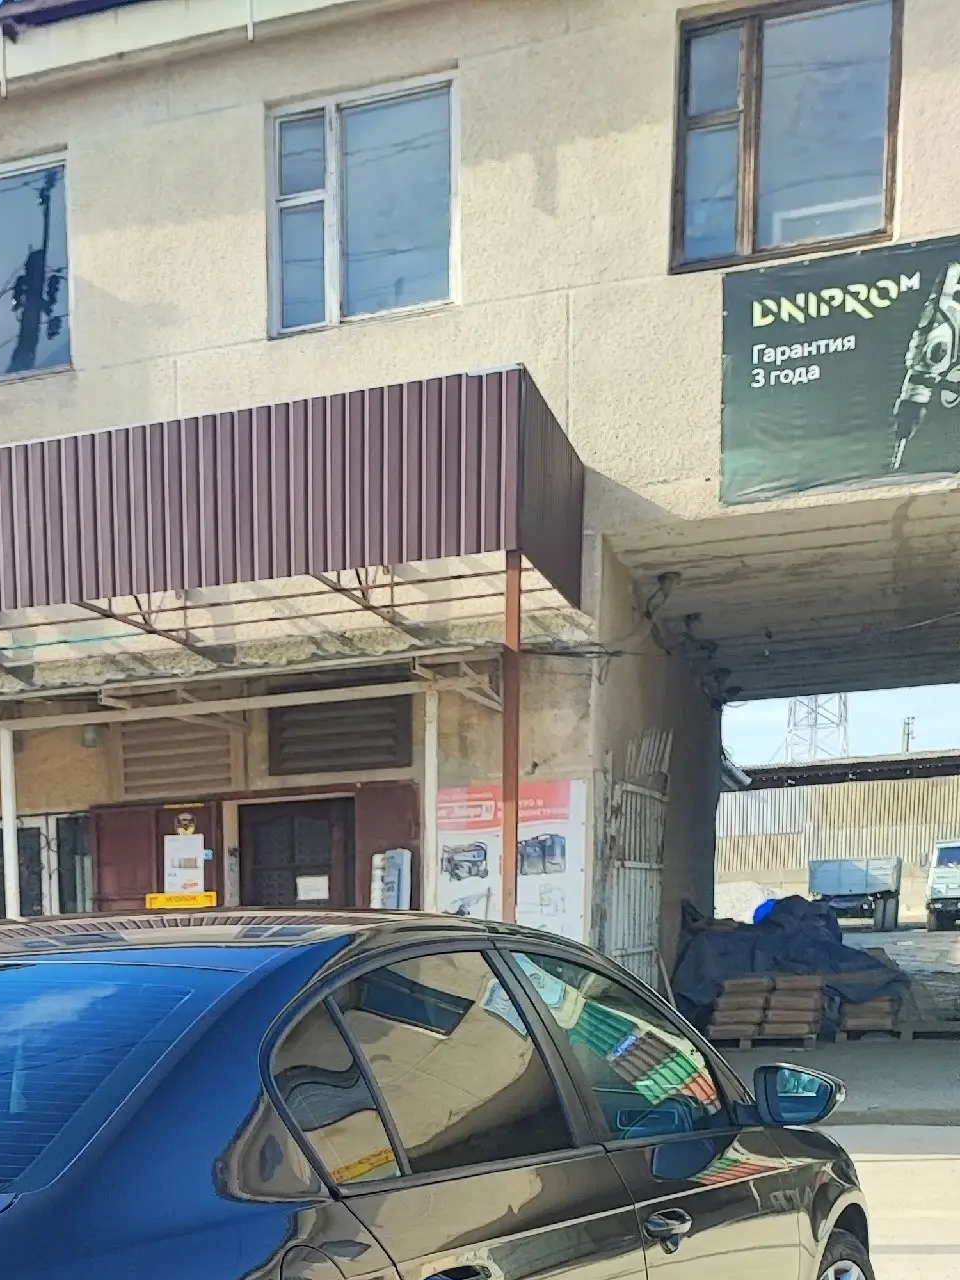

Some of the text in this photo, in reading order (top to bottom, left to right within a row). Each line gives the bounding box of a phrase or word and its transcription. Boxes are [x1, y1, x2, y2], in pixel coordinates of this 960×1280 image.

[752, 335, 856, 365] Гарантия
[751, 364, 821, 388] 3 года
